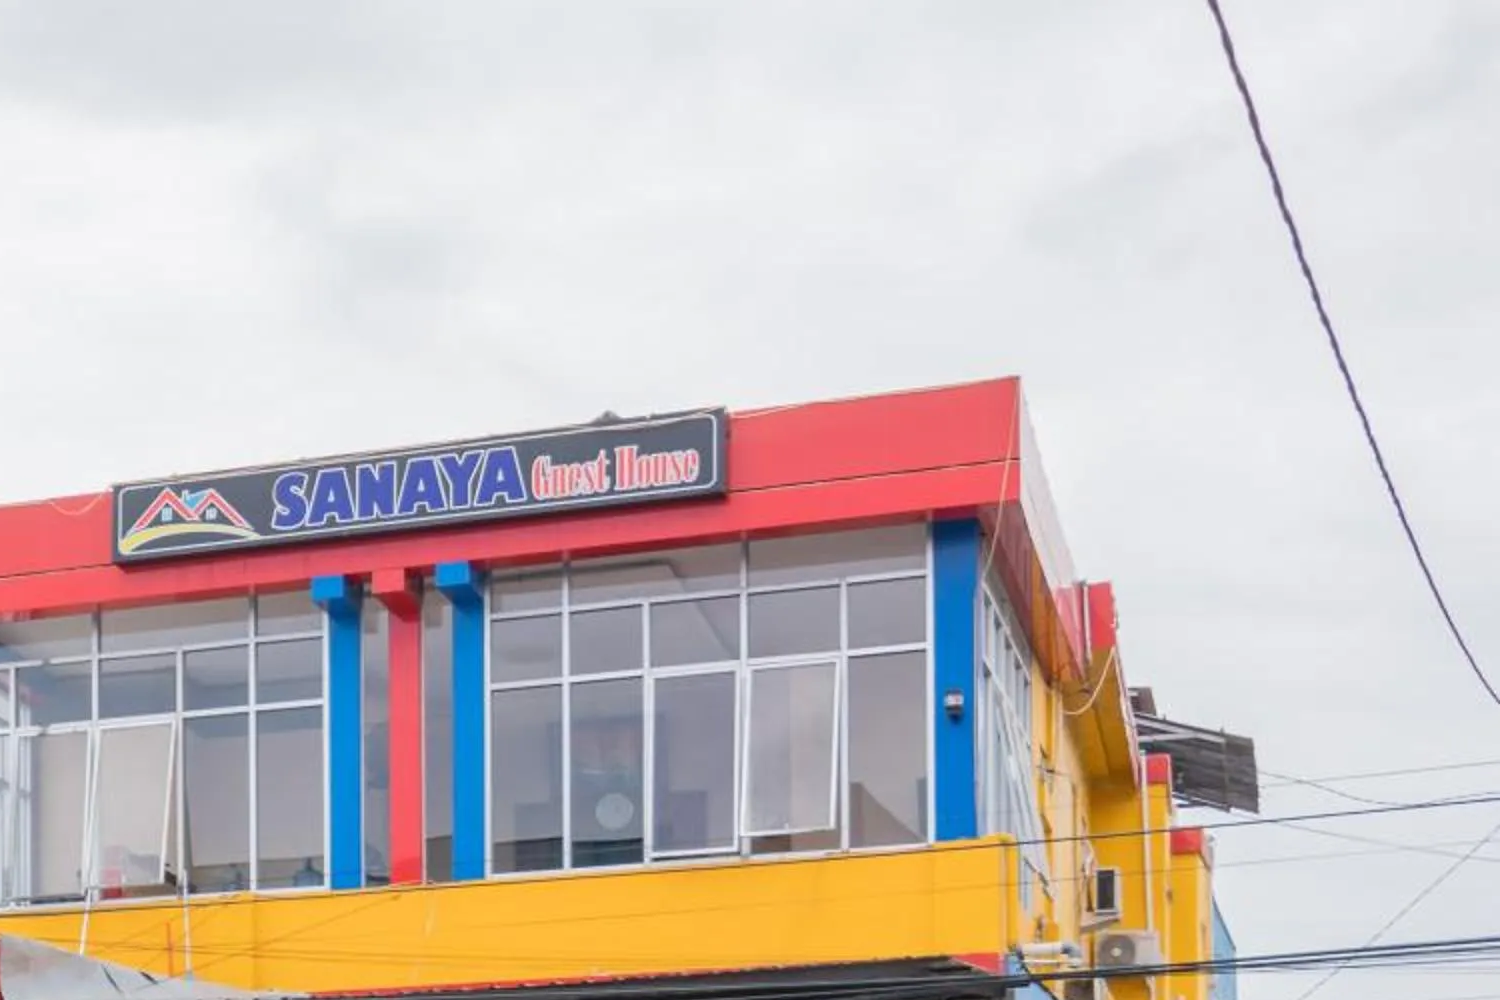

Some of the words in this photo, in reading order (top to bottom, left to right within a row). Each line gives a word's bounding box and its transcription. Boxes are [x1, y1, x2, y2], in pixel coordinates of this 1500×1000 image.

[270, 445, 527, 531] SANAYA
[531, 448, 611, 500] Guest
[614, 445, 700, 491] House
